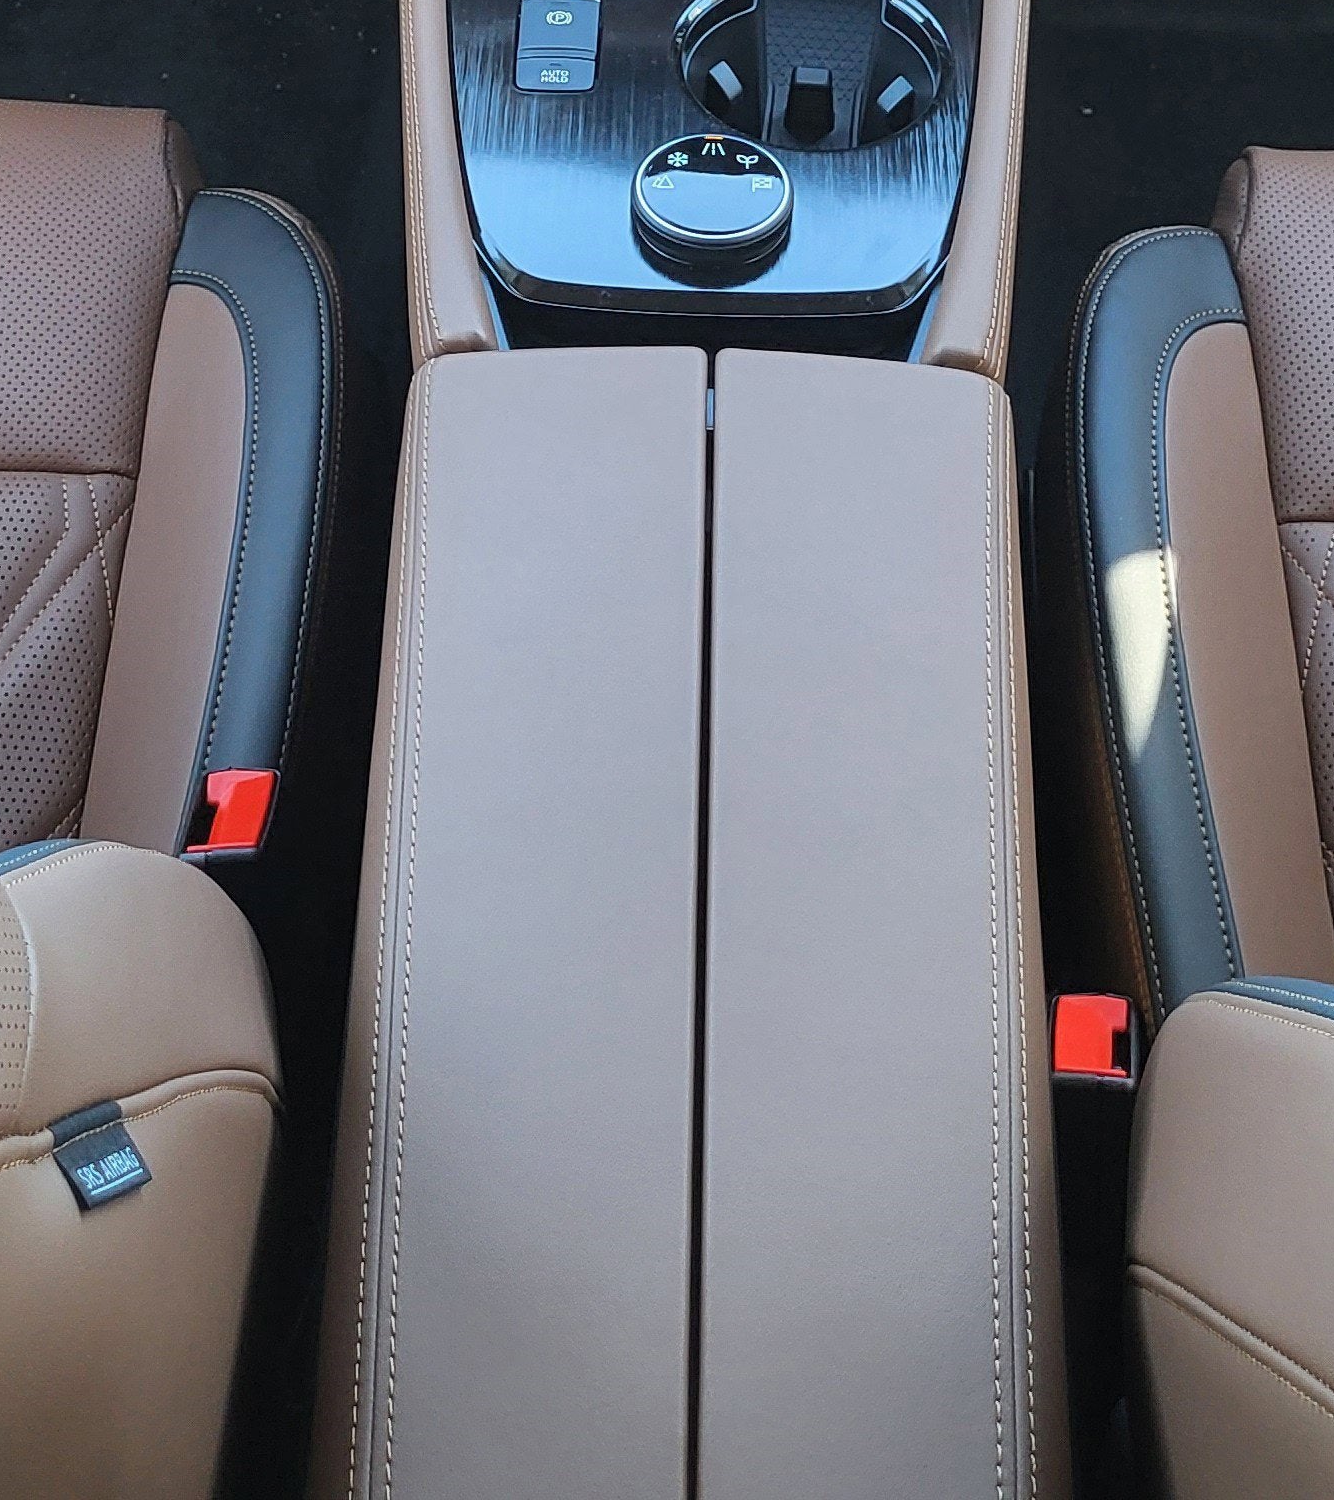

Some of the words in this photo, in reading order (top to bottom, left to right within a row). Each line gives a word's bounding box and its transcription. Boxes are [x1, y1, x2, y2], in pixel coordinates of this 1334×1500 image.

[540, 69, 569, 77] AUTO
[76, 1162, 105, 1190] SRS
[99, 1146, 140, 1181] AIRBAG
